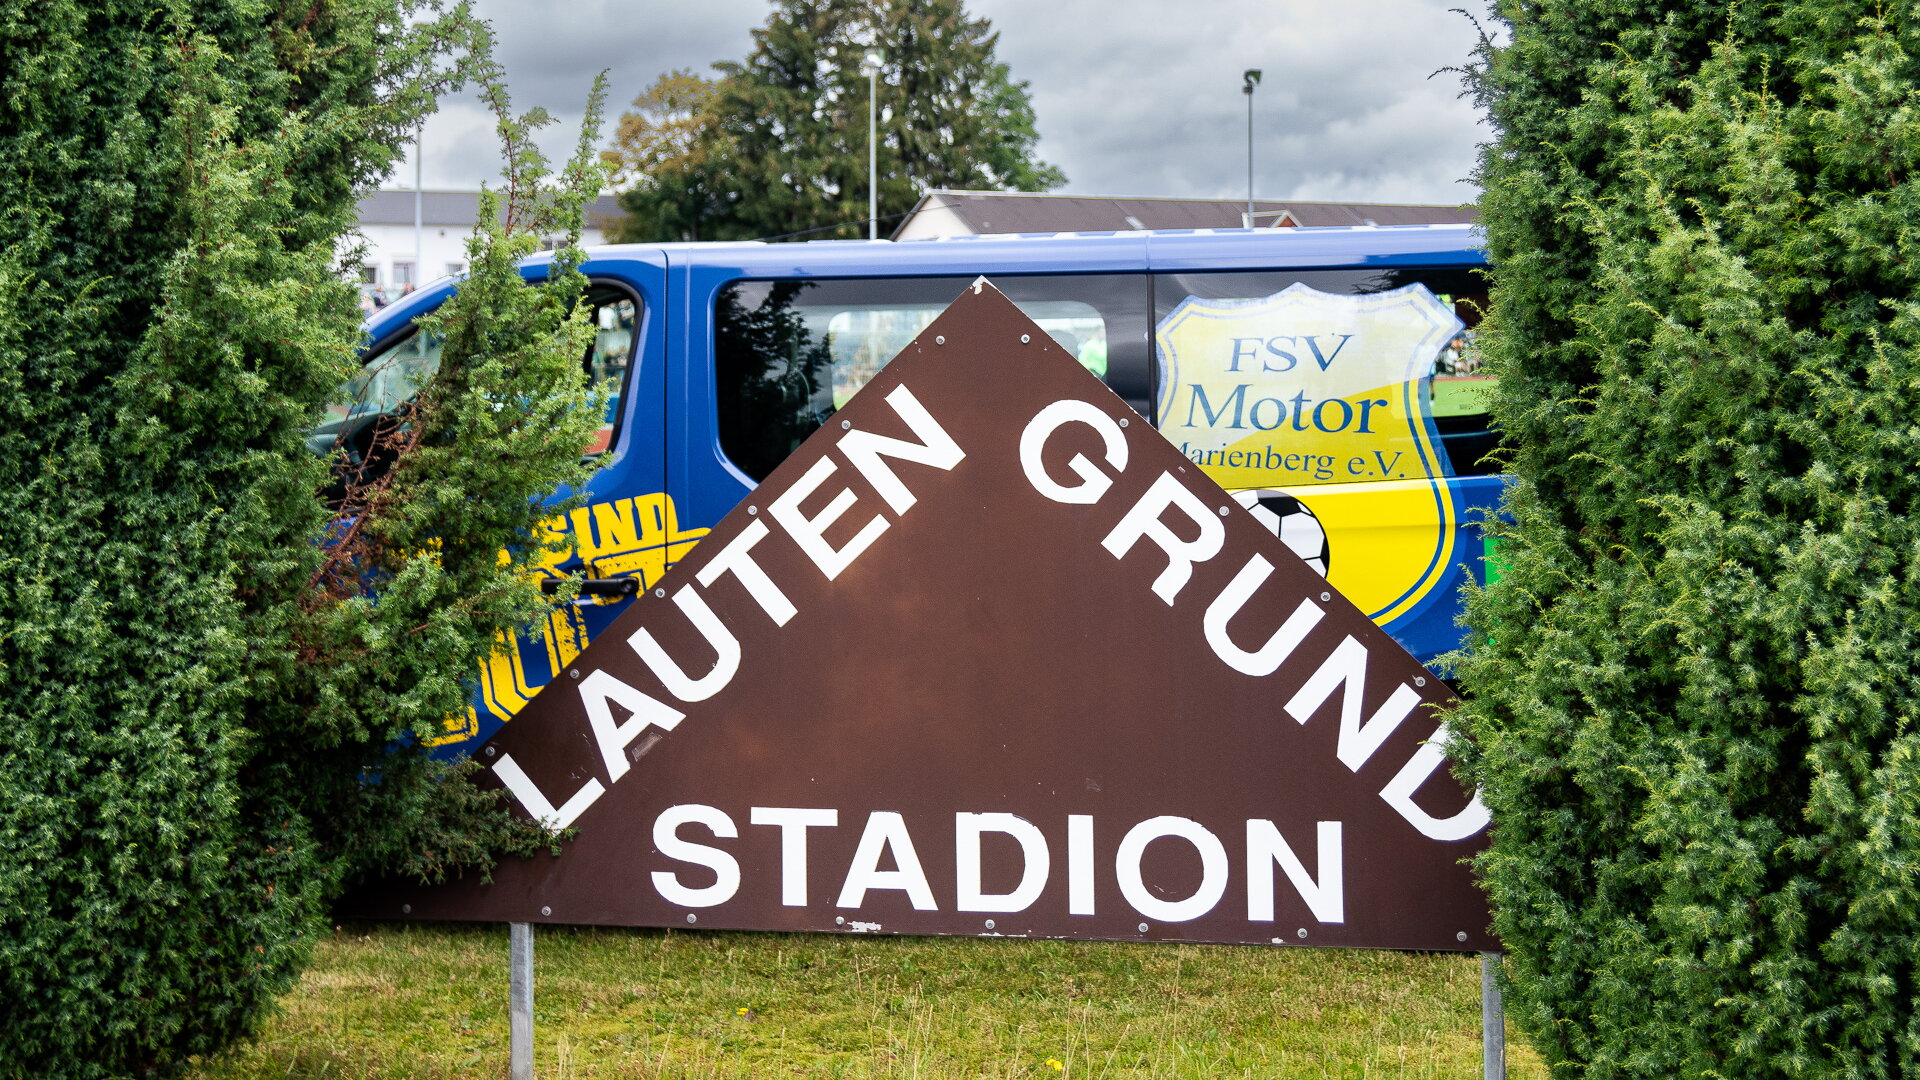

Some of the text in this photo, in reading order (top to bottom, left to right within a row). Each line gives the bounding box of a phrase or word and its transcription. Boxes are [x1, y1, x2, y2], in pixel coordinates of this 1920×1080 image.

[1225, 334, 1354, 372] FSV
[1183, 384, 1388, 433] Motor
[1179, 442, 1405, 480] arienberg e.V.
[531, 492, 679, 568] SIND
[492, 383, 966, 836] LAUTEN
[1019, 399, 1492, 841] GRUND
[651, 804, 1344, 924] STADION
